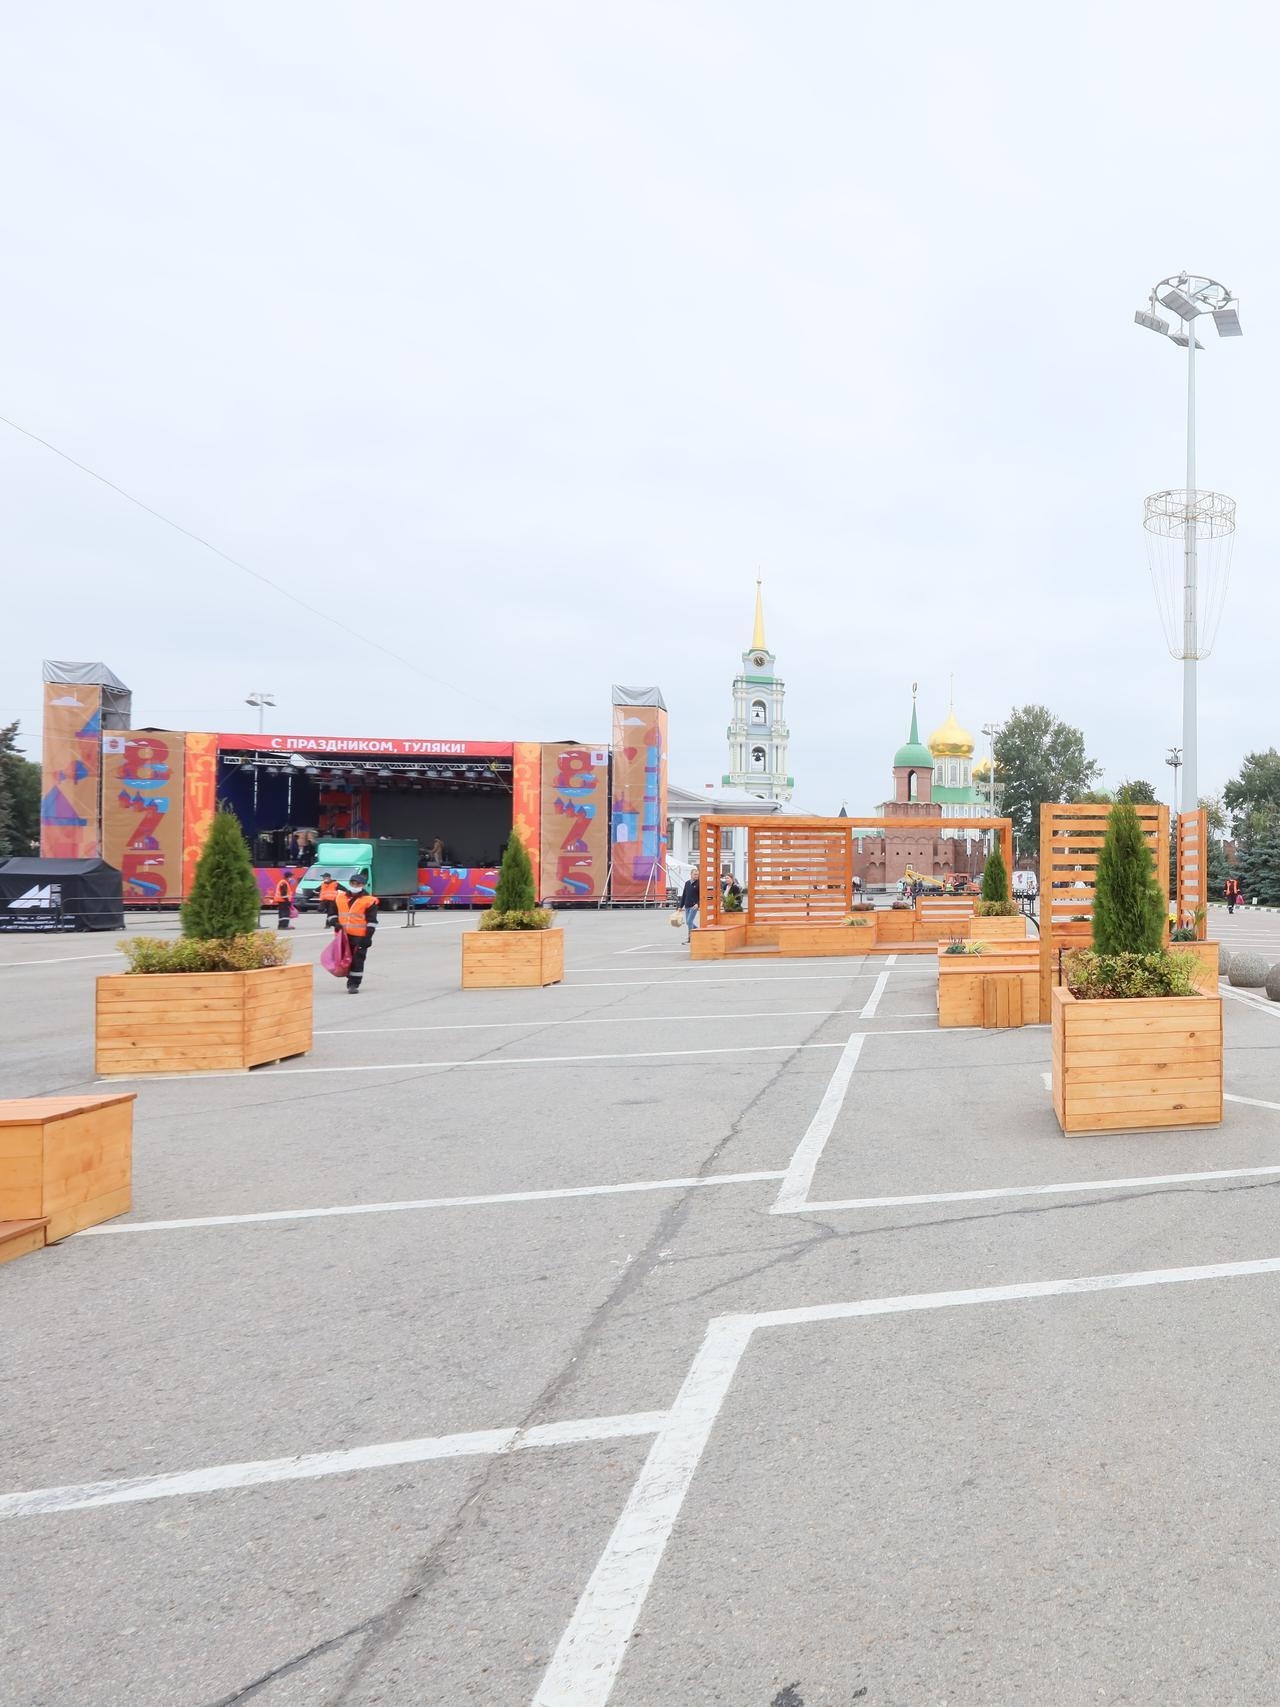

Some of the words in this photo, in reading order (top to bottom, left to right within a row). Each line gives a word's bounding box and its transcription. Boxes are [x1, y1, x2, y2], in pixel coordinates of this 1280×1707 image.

[271, 738, 283, 749] С
[286, 738, 398, 754] ПРАЗДНИКОМ,
[403, 741, 466, 754] ТУЛЯКИ!
